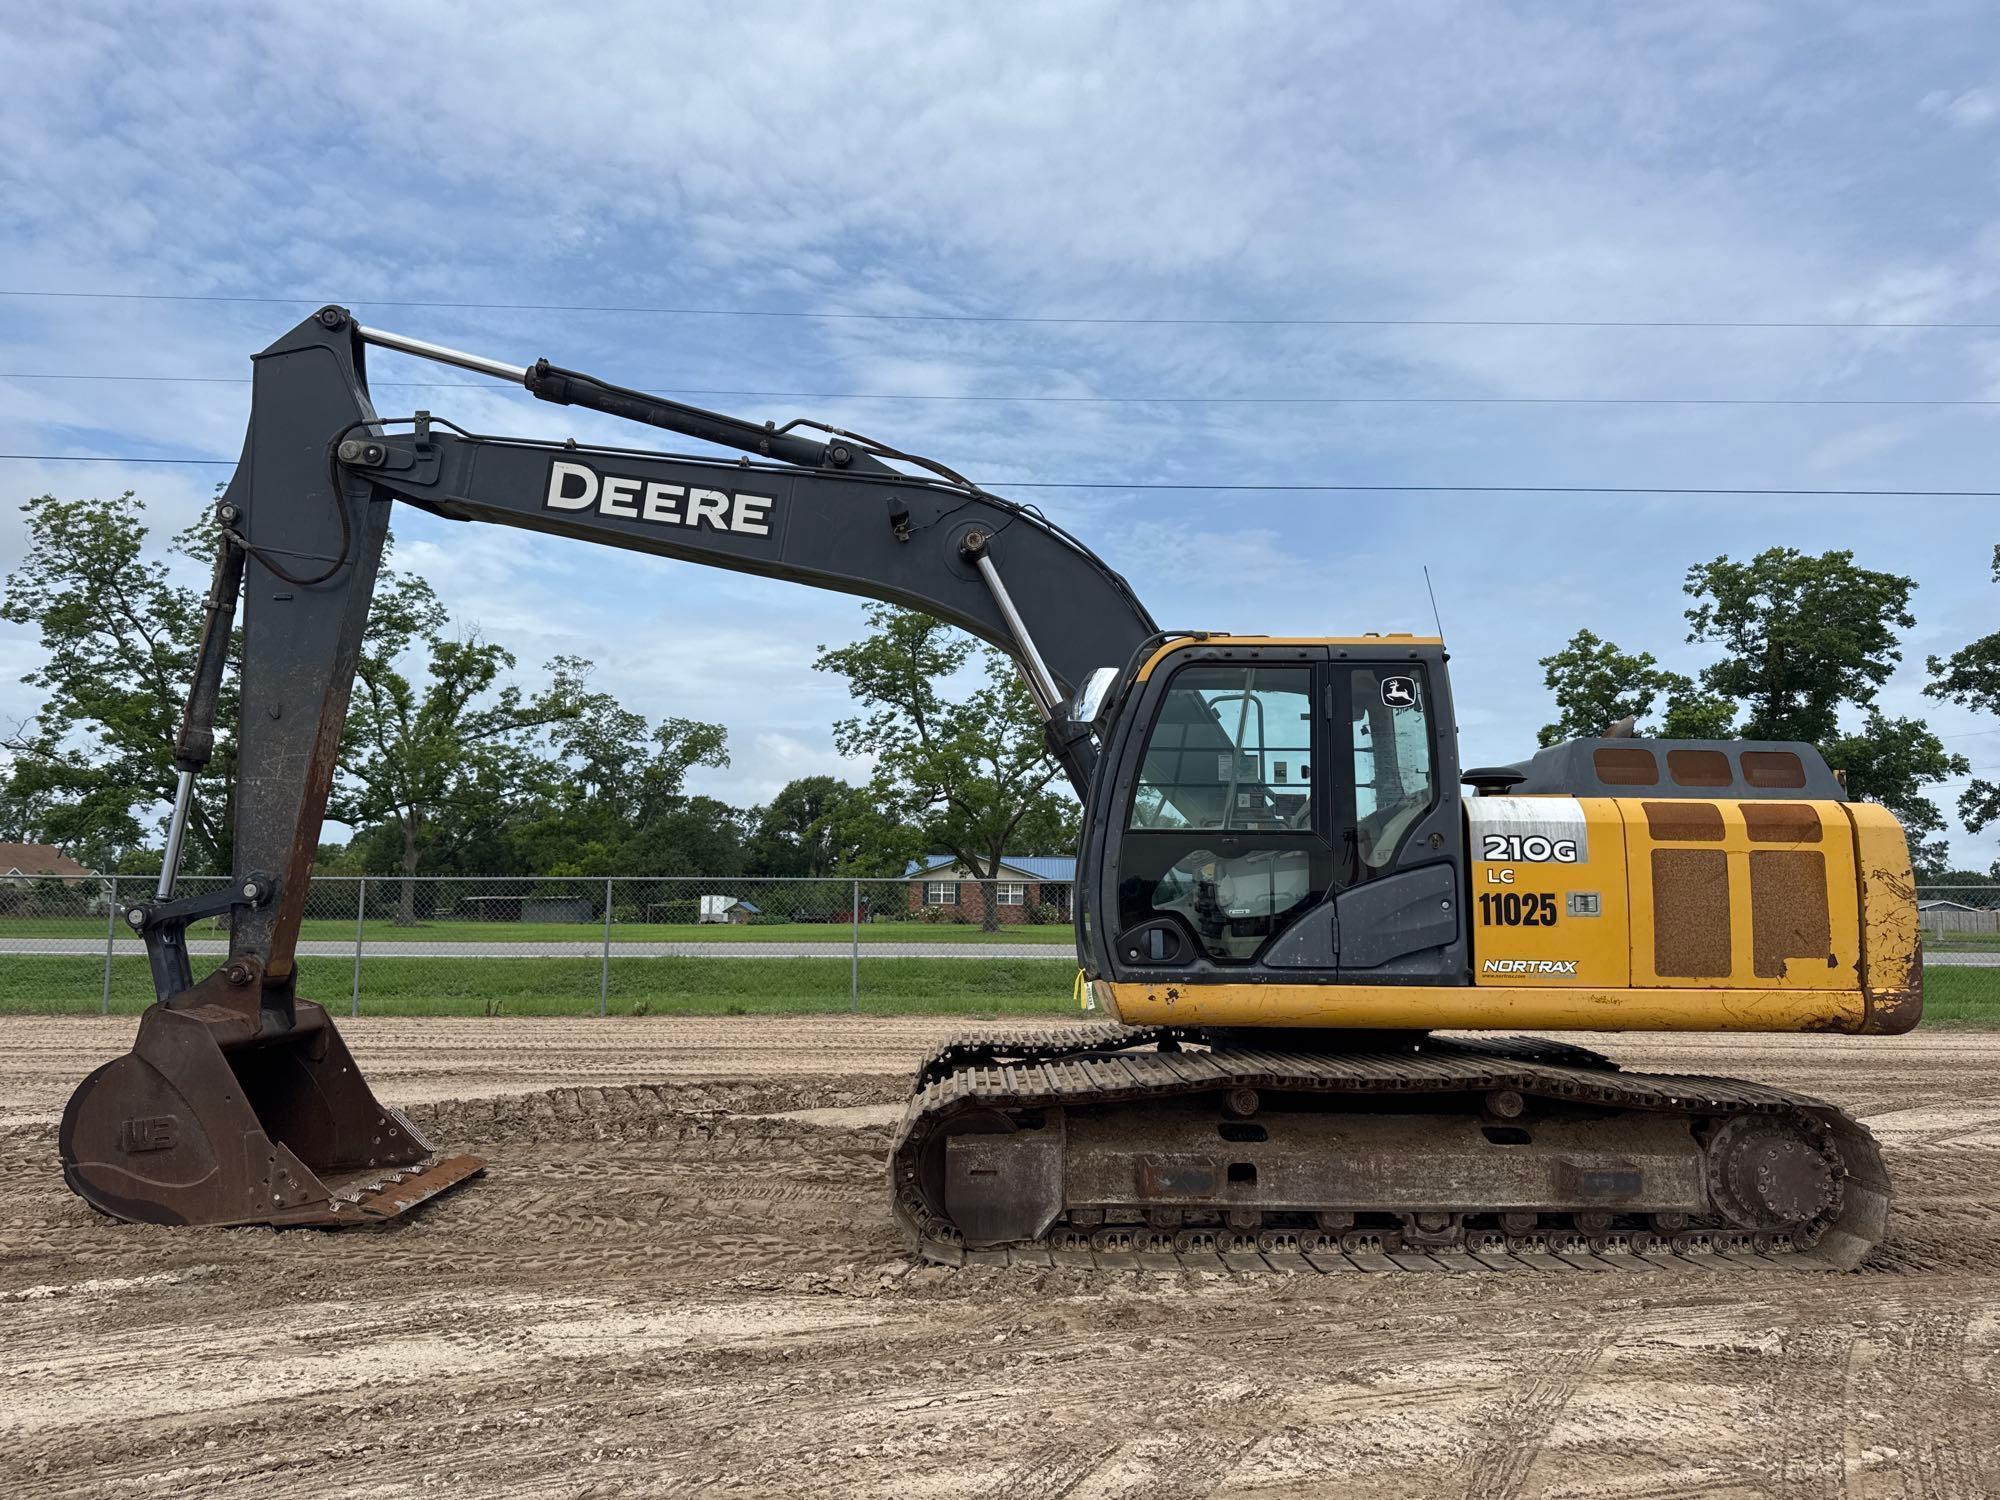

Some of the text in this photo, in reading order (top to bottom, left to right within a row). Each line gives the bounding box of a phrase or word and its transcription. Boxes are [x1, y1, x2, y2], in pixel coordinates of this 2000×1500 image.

[547, 461, 773, 536] DEERE
[1484, 835, 1577, 863] 210G
[1487, 869, 1515, 884] LC
[1479, 893, 1557, 926] 11025
[1482, 959, 1579, 974] NORTRAX
